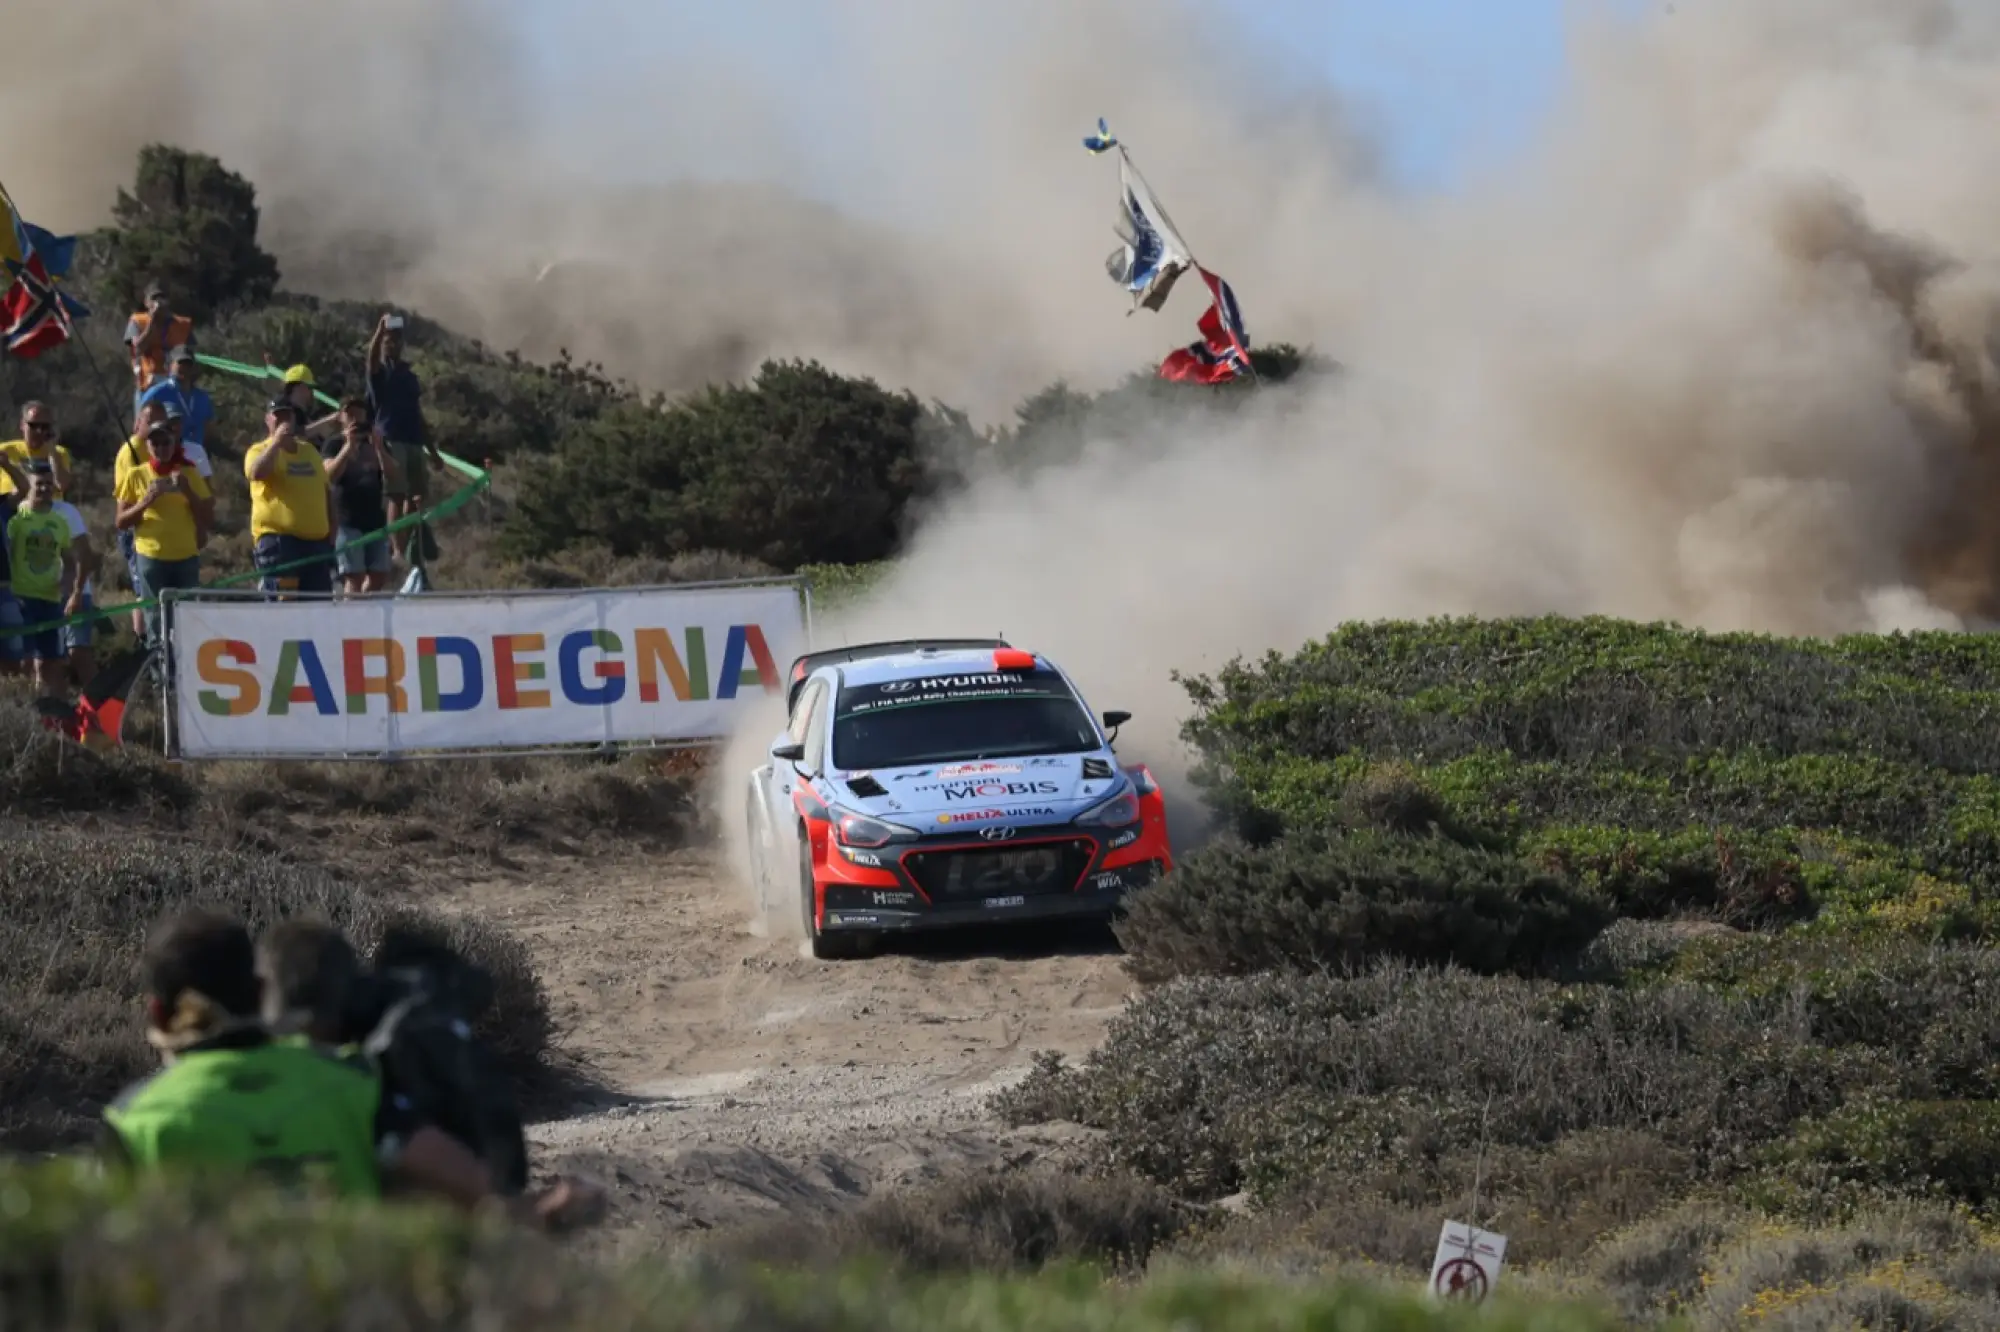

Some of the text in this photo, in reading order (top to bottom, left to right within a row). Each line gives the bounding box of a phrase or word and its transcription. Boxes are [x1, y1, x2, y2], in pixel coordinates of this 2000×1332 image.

[196, 623, 783, 716] SARDEGNA
[921, 674, 1023, 689] HYUNDAI
[914, 776, 1002, 793] HYUNDAI
[944, 780, 1060, 801] MOBIS
[952, 807, 1056, 823] HELIX ULTRA
